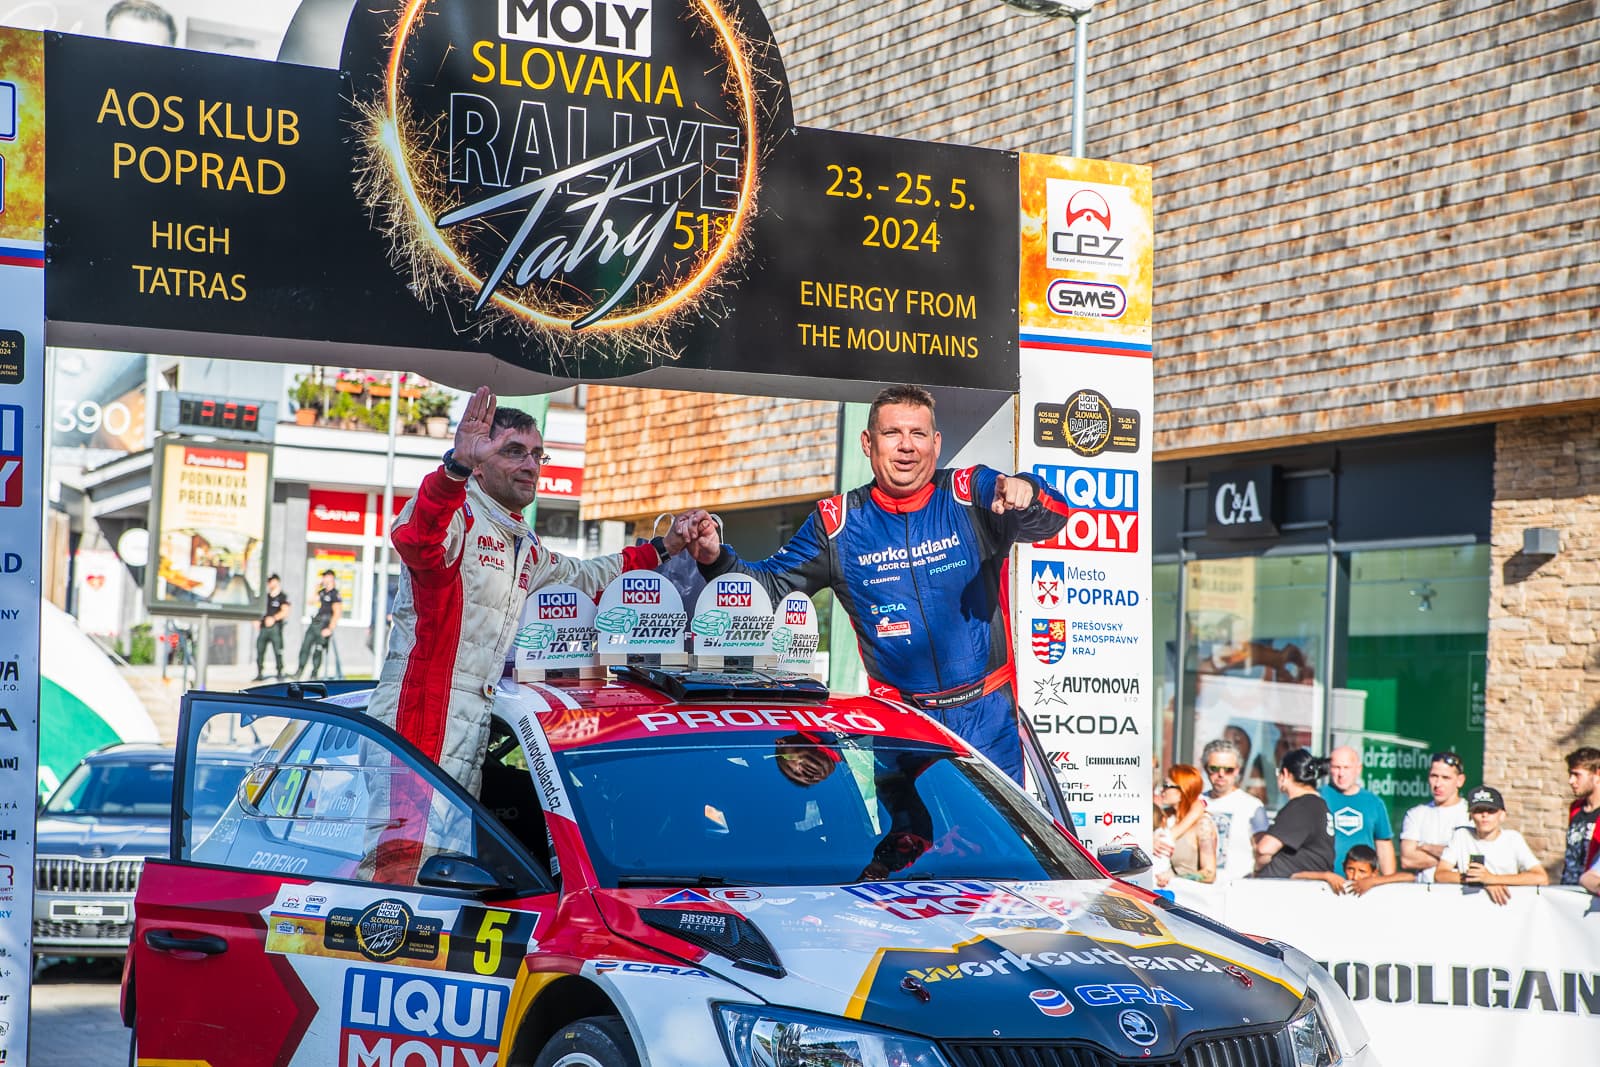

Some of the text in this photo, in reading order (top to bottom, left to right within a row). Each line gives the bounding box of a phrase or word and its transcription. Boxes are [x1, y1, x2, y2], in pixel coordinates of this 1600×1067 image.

[506, 0, 650, 51] MOLY
[471, 40, 684, 107] SLOVAKIA
[97, 88, 300, 146] AOS KLUB
[450, 93, 740, 212] RALLYE
[113, 142, 286, 195] POPRAD
[151, 221, 230, 255] HIGH
[437, 136, 701, 330] Tatry
[673, 211, 734, 251] 51st
[862, 215, 941, 253] 2024
[132, 265, 247, 301] TATRAS
[800, 280, 977, 320] ENERGY FROM
[1059, 290, 1116, 309] SAMŠ
[1073, 310, 1100, 318] SLOVAKIA
[798, 323, 979, 359] THE MOUNTAINS
[1080, 395, 1098, 403] LIQUI
[1075, 411, 1102, 419] SLOVAKIA
[1070, 418, 1107, 433] RALLYE
[1215, 480, 1262, 525] C&A
[1037, 511, 1137, 549] OLY
[877, 562, 899, 572] ACCR
[926, 553, 946, 563] Team
[930, 560, 967, 575] PROFIKO
[1068, 566, 1106, 581] Mesto
[625, 580, 658, 591] LIQUI
[718, 583, 750, 594] LIQUI
[541, 594, 576, 606] LIQUI
[624, 592, 659, 602] MOLY
[718, 595, 751, 606] MOLY
[1067, 587, 1139, 607] POPRAD
[541, 606, 576, 618] MOLY
[787, 601, 807, 611] LIQUI
[880, 603, 906, 613] CRA
[640, 612, 687, 620] SLOVAKIA
[786, 612, 806, 624] MOLY
[632, 628, 680, 638] TATRY
[725, 631, 770, 640] TATRY
[550, 641, 597, 652] TATRY
[788, 648, 814, 658] TATRY
[1072, 647, 1096, 656] KRAJ
[1062, 677, 1140, 694] AUTONOVA
[637, 709, 886, 732] PROFIKO
[370, 917, 399, 925] SLOVAKIA
[681, 913, 726, 926] BRYNDA
[679, 924, 725, 933] racing
[473, 909, 511, 975] 5
[622, 963, 710, 978] CRA
[906, 947, 1222, 984] workoutland
[1316, 961, 1600, 1015] OOLIGAN
[1075, 984, 1194, 1011] CRA
[350, 974, 502, 1041] LIQUI
